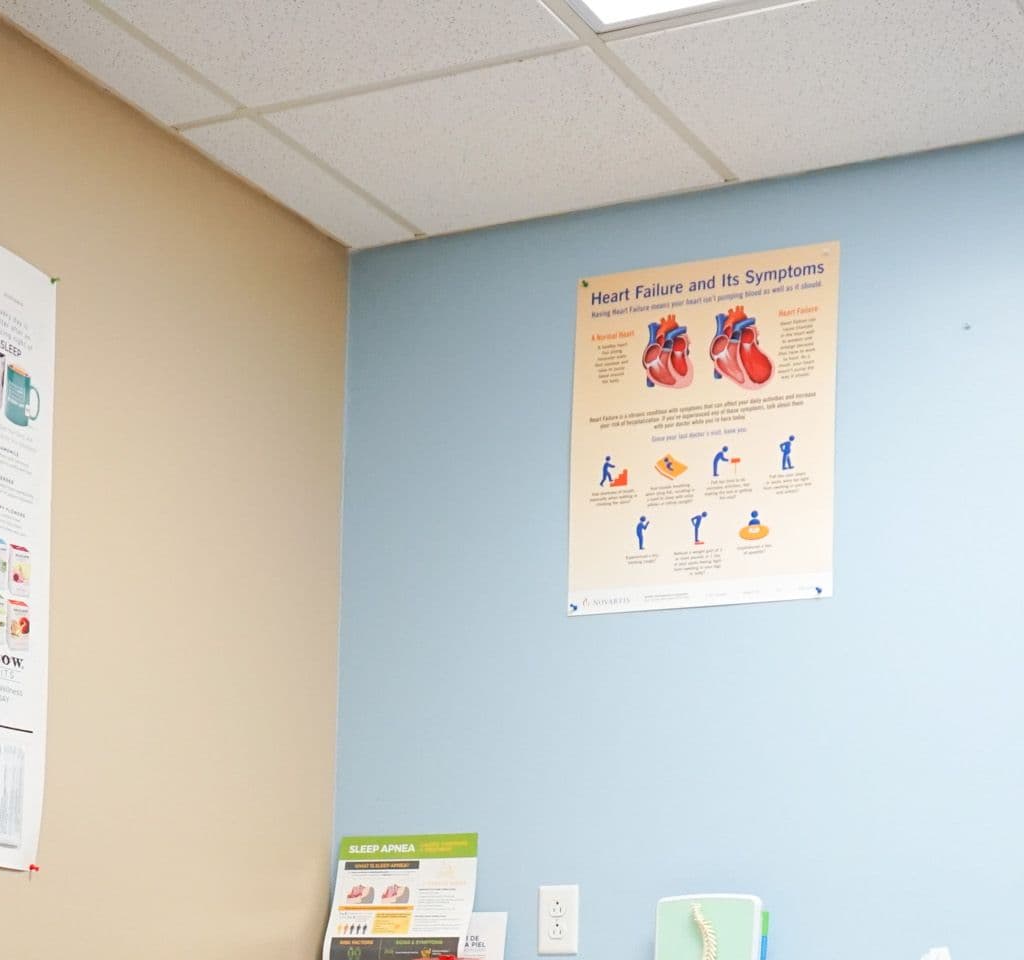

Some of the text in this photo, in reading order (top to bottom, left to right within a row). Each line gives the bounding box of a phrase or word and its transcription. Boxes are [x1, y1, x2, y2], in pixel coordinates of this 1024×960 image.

[592, 263, 825, 305] Heart Failure and Its Symptoms
[592, 310, 610, 318] Having
[612, 308, 628, 316] Heart
[745, 289, 762, 297] blood
[0, 340, 22, 357] SLEEP
[348, 844, 380, 854] SLEEP
[380, 843, 416, 853] APNEA
